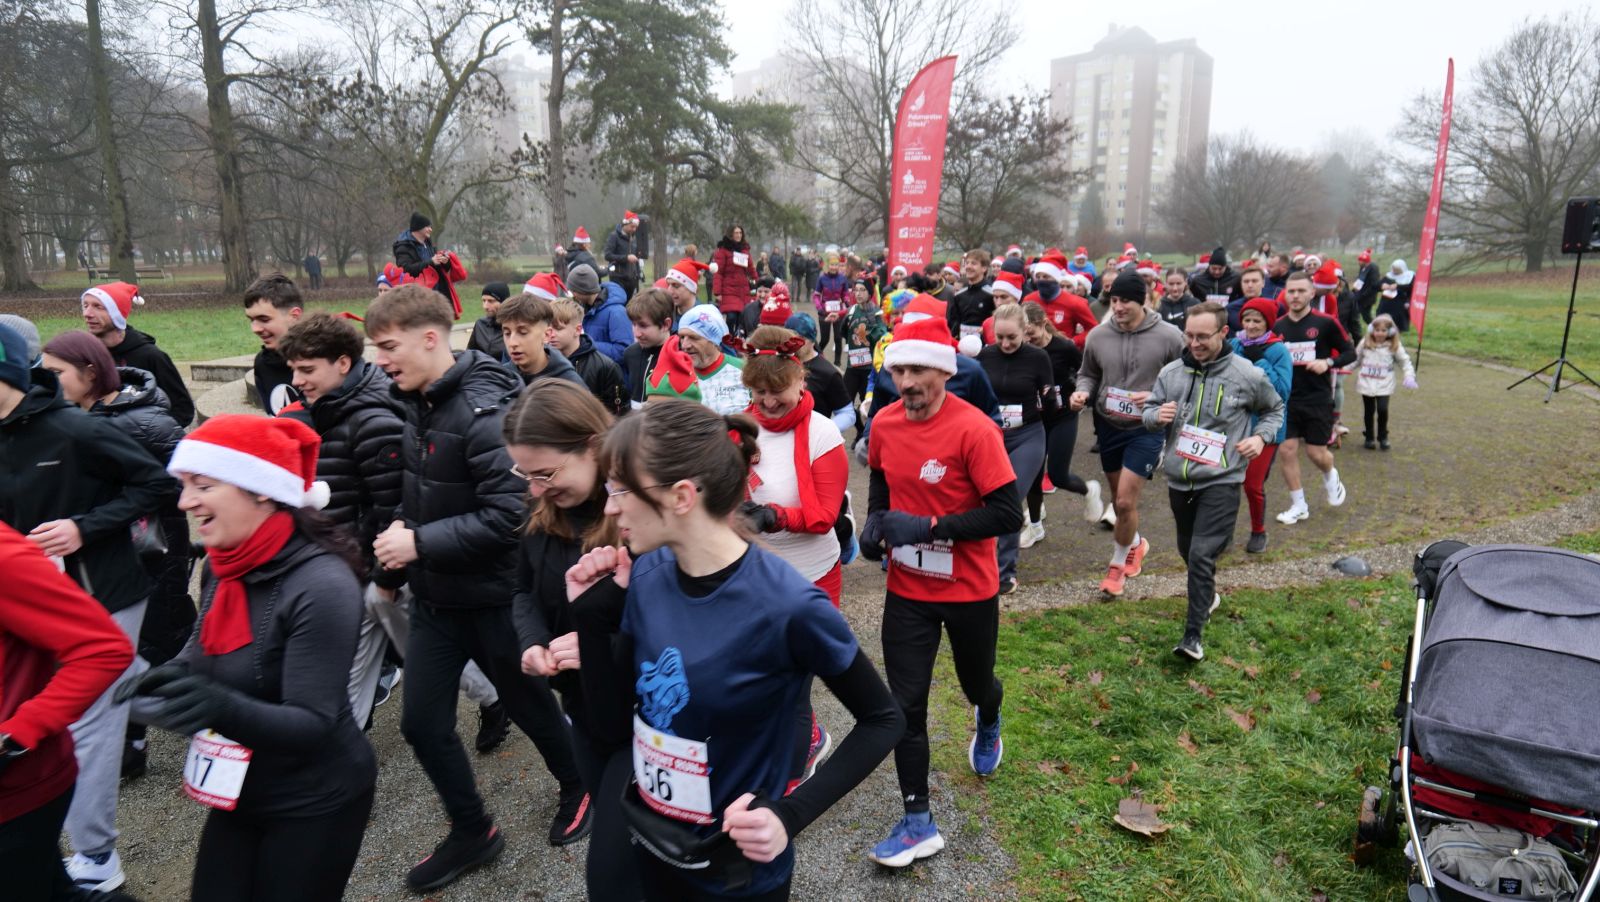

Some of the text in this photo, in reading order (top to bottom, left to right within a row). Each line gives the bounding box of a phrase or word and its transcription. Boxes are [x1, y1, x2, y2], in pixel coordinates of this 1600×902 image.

[1293, 351, 1305, 361] 92
[1118, 401, 1133, 415] 96
[1190, 441, 1209, 457] 97
[915, 550, 923, 568] 1
[192, 753, 212, 787] 17
[644, 761, 673, 802] 56
